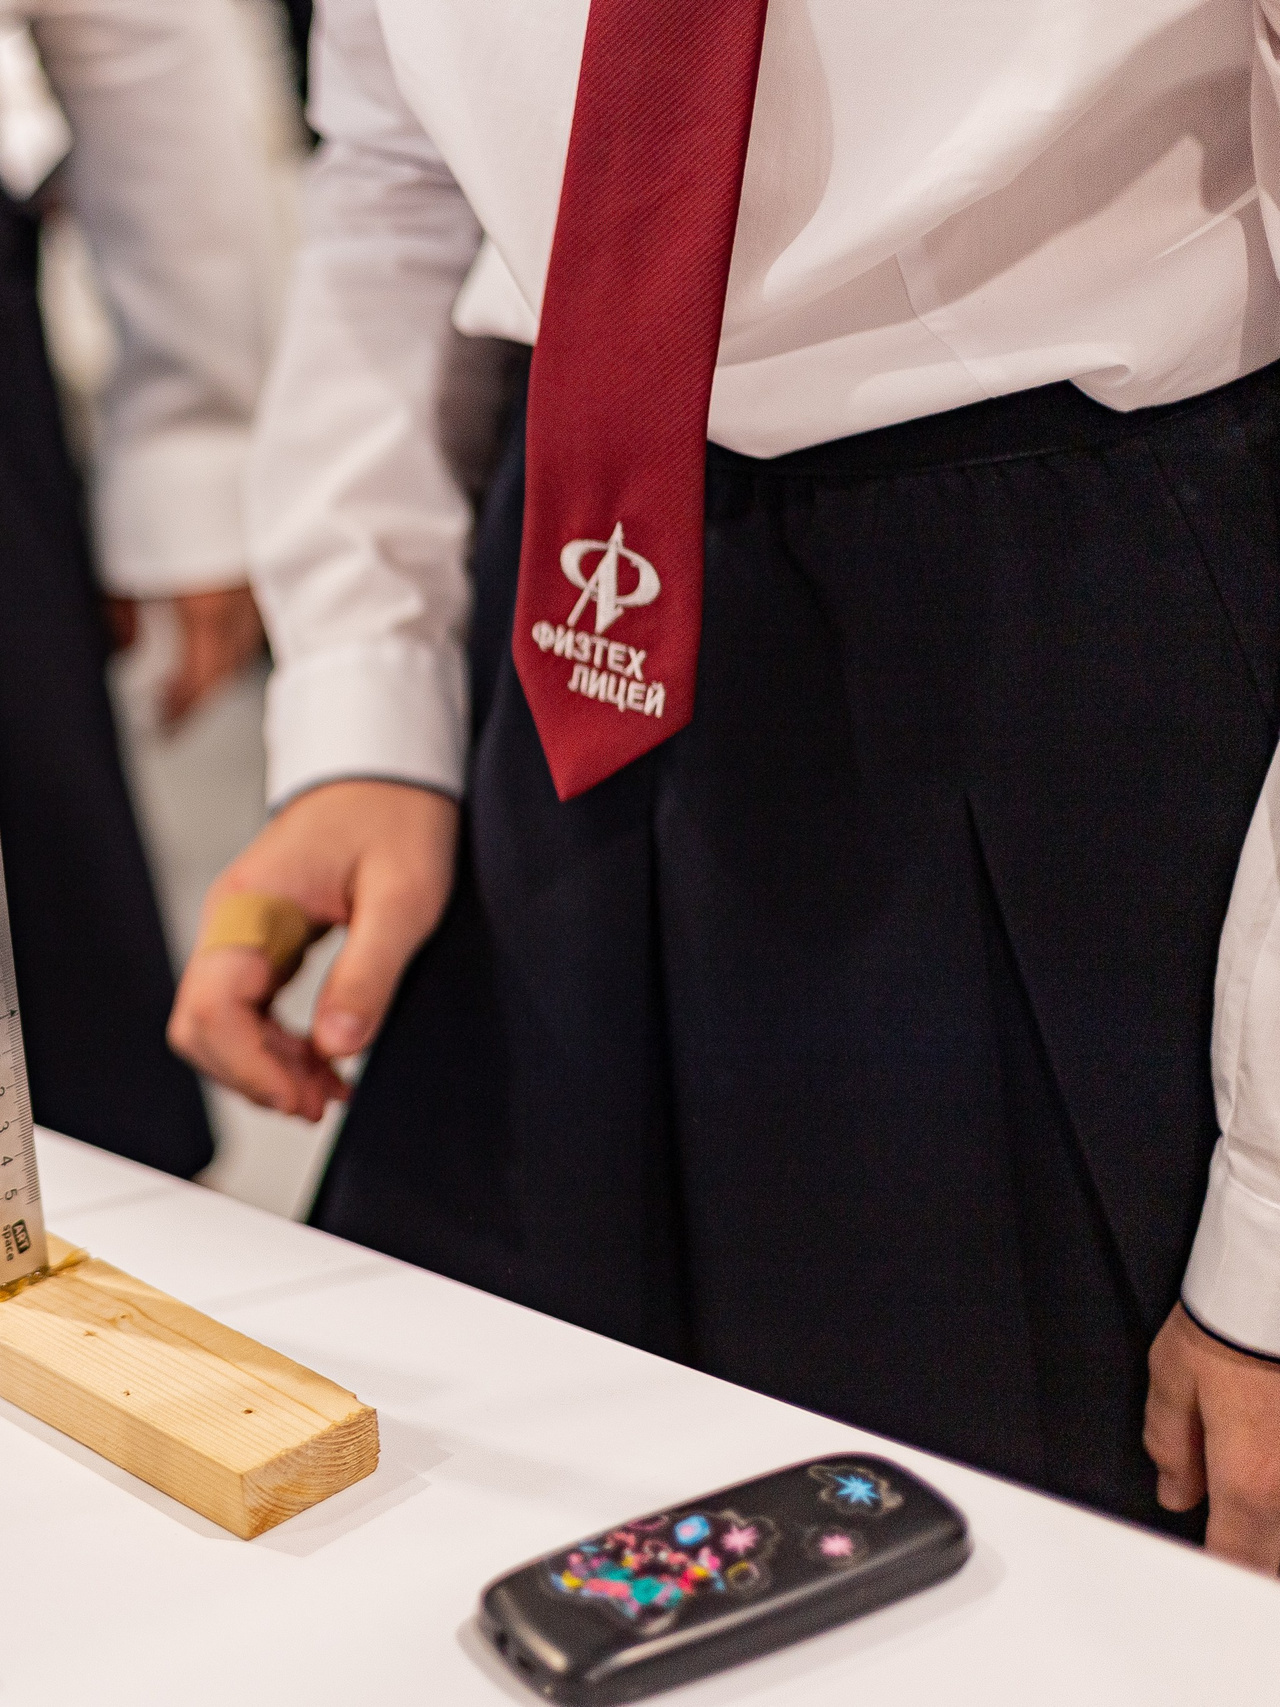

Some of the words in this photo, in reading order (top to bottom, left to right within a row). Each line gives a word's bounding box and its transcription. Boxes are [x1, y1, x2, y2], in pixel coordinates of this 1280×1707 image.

[531, 619, 647, 682] ФИЗТЕХ
[567, 662, 667, 720] ЛИЦЕЙ
[1, 1156, 13, 1167] 4
[5, 1188, 18, 1201] 5
[1, 1223, 15, 1261] space
[12, 1222, 30, 1250] ART
